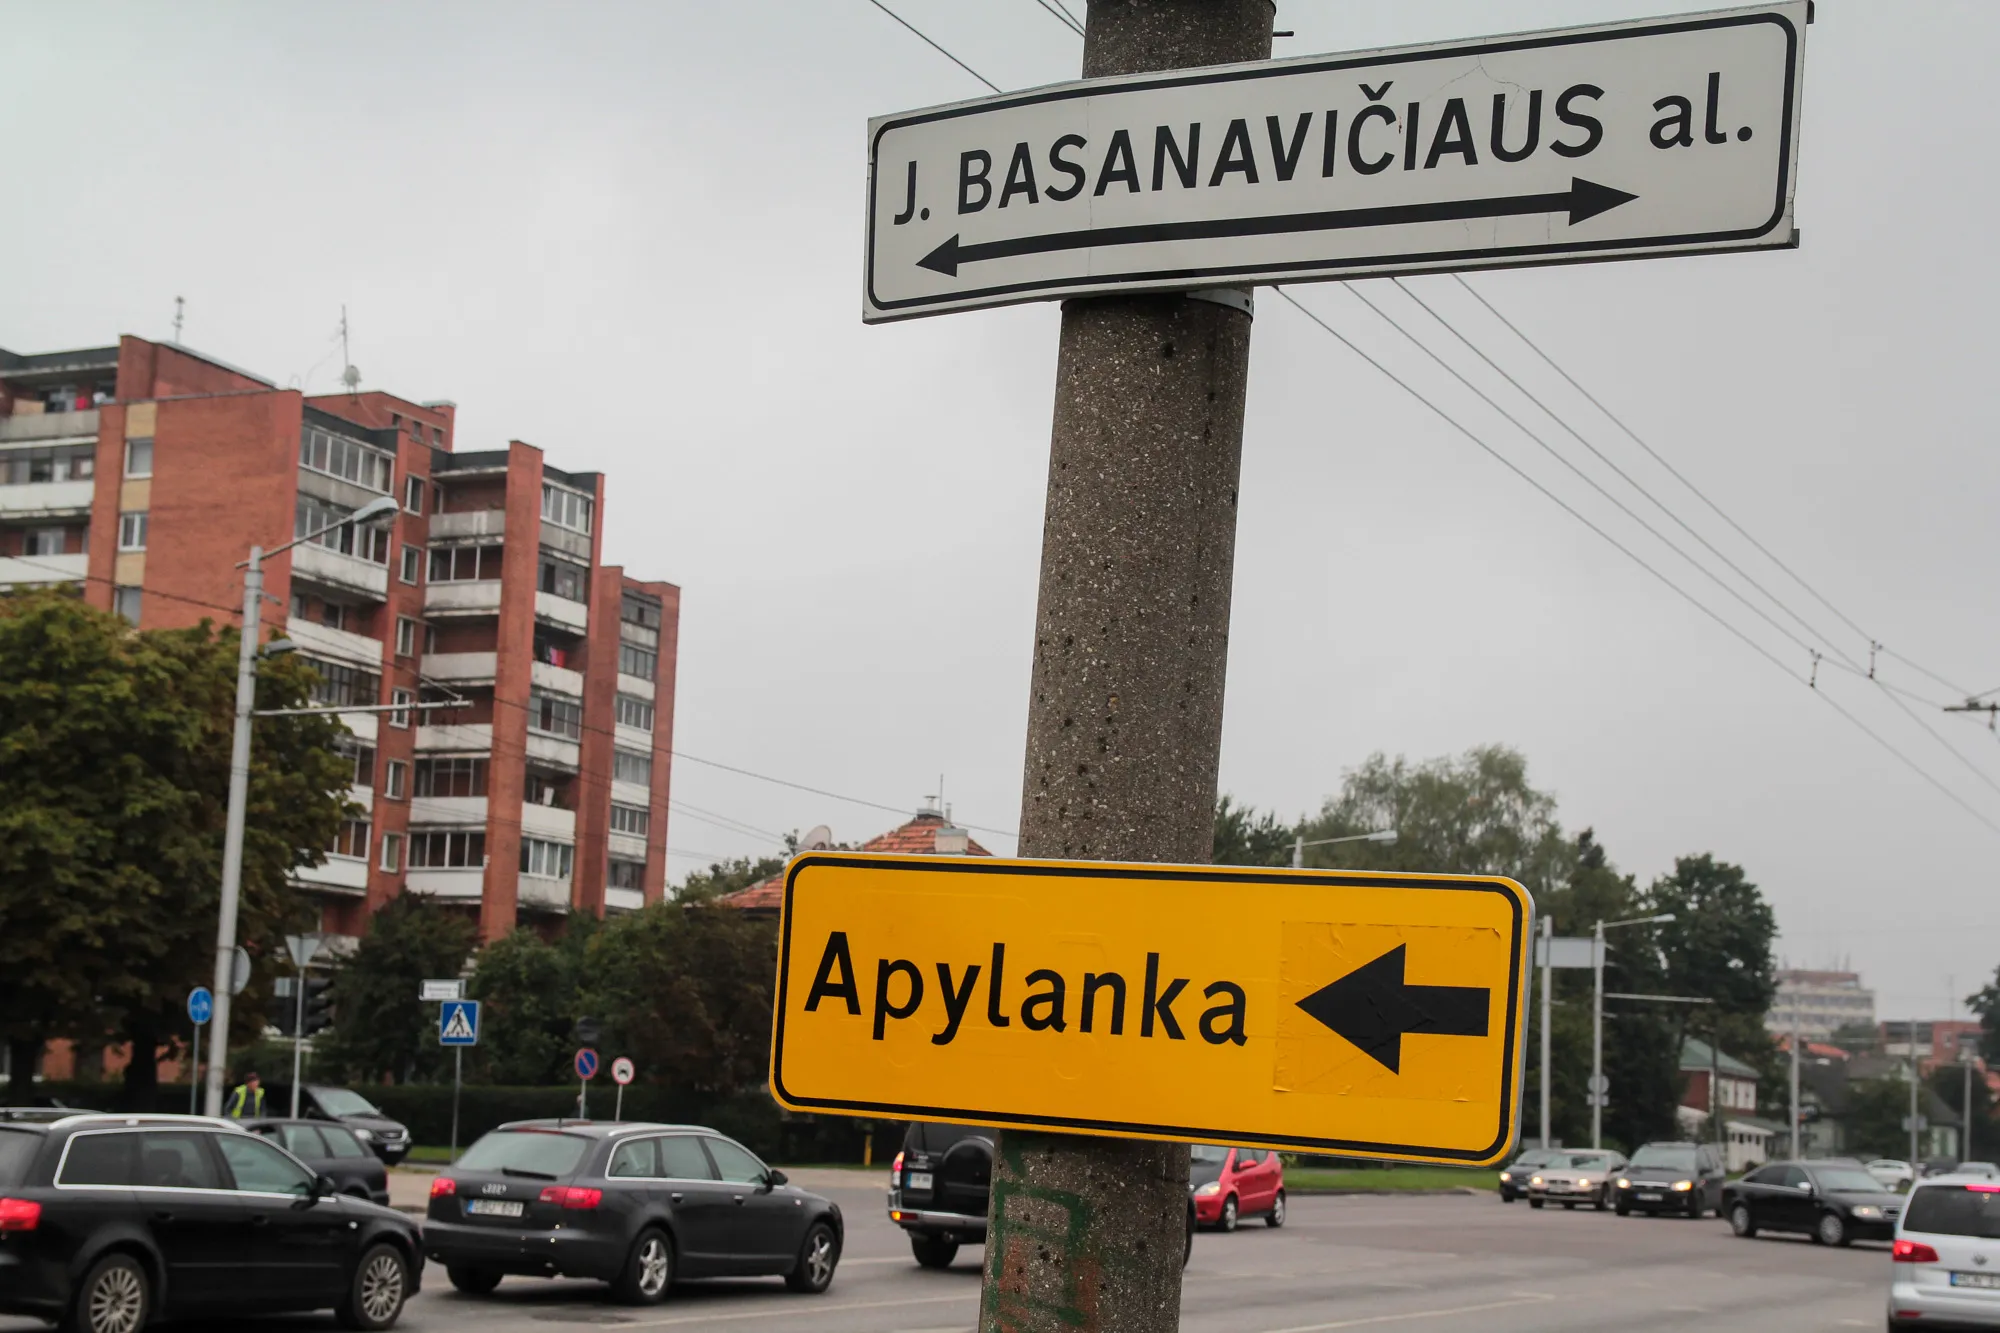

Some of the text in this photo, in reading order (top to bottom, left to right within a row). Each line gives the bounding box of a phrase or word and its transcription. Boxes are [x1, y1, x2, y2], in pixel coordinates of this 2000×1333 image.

[893, 71, 1754, 226] J. BASANAVIČIAUS al.
[803, 931, 1249, 1047] Apylanka
